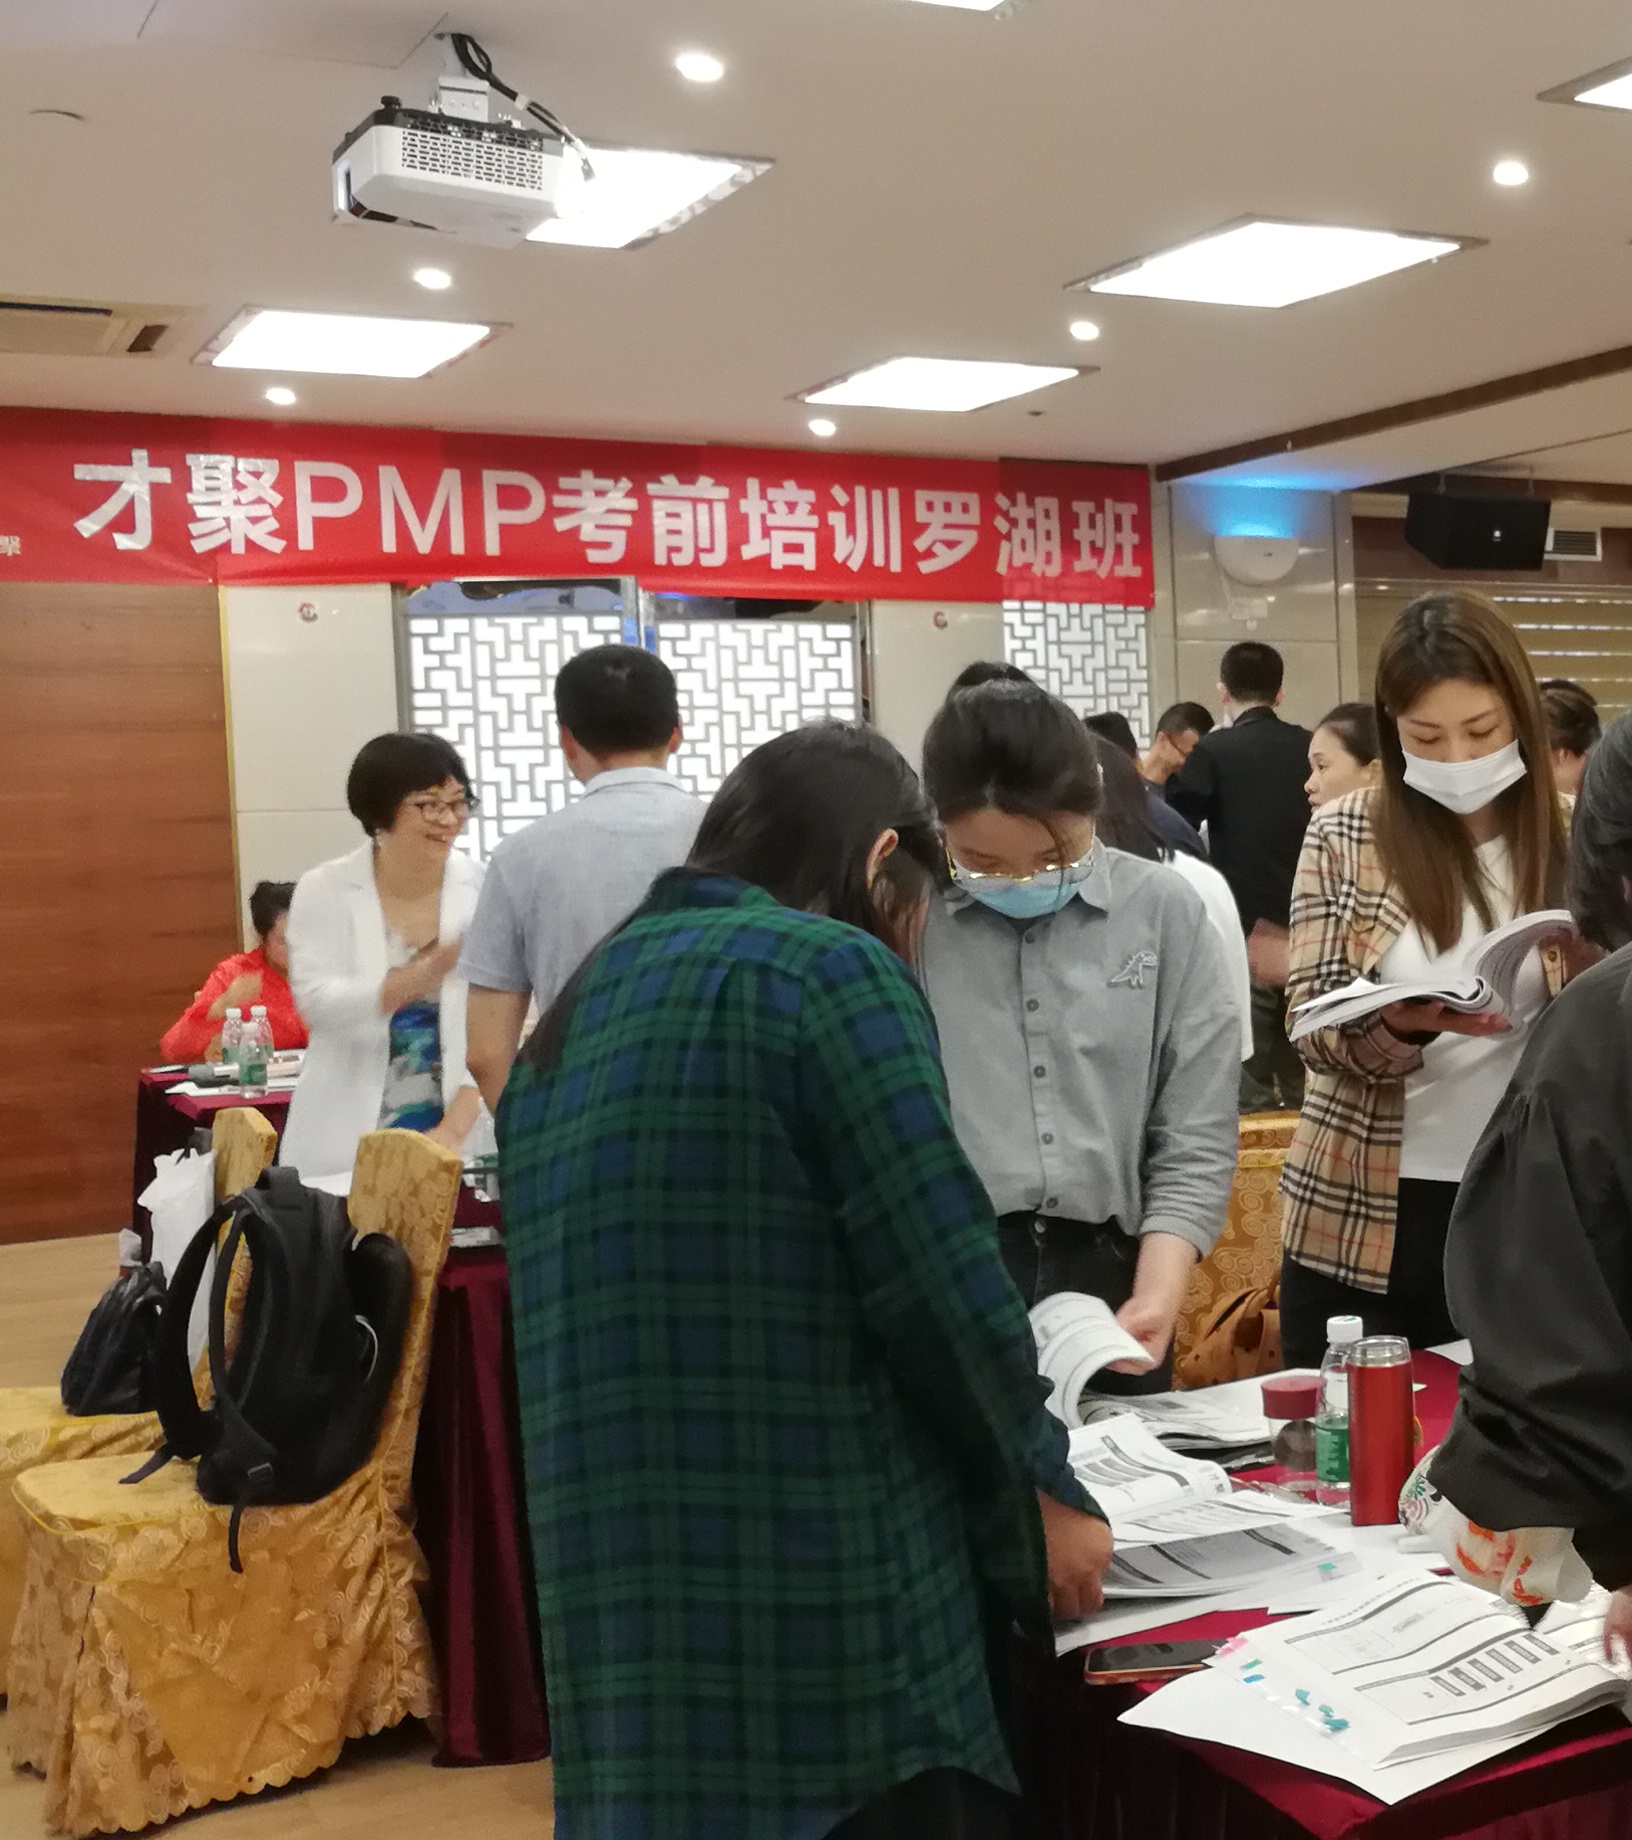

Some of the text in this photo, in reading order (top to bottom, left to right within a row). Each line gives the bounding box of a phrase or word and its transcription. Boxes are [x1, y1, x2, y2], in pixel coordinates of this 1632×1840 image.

[73, 448, 1142, 579] 才聚PMP考前培训罗湖班
